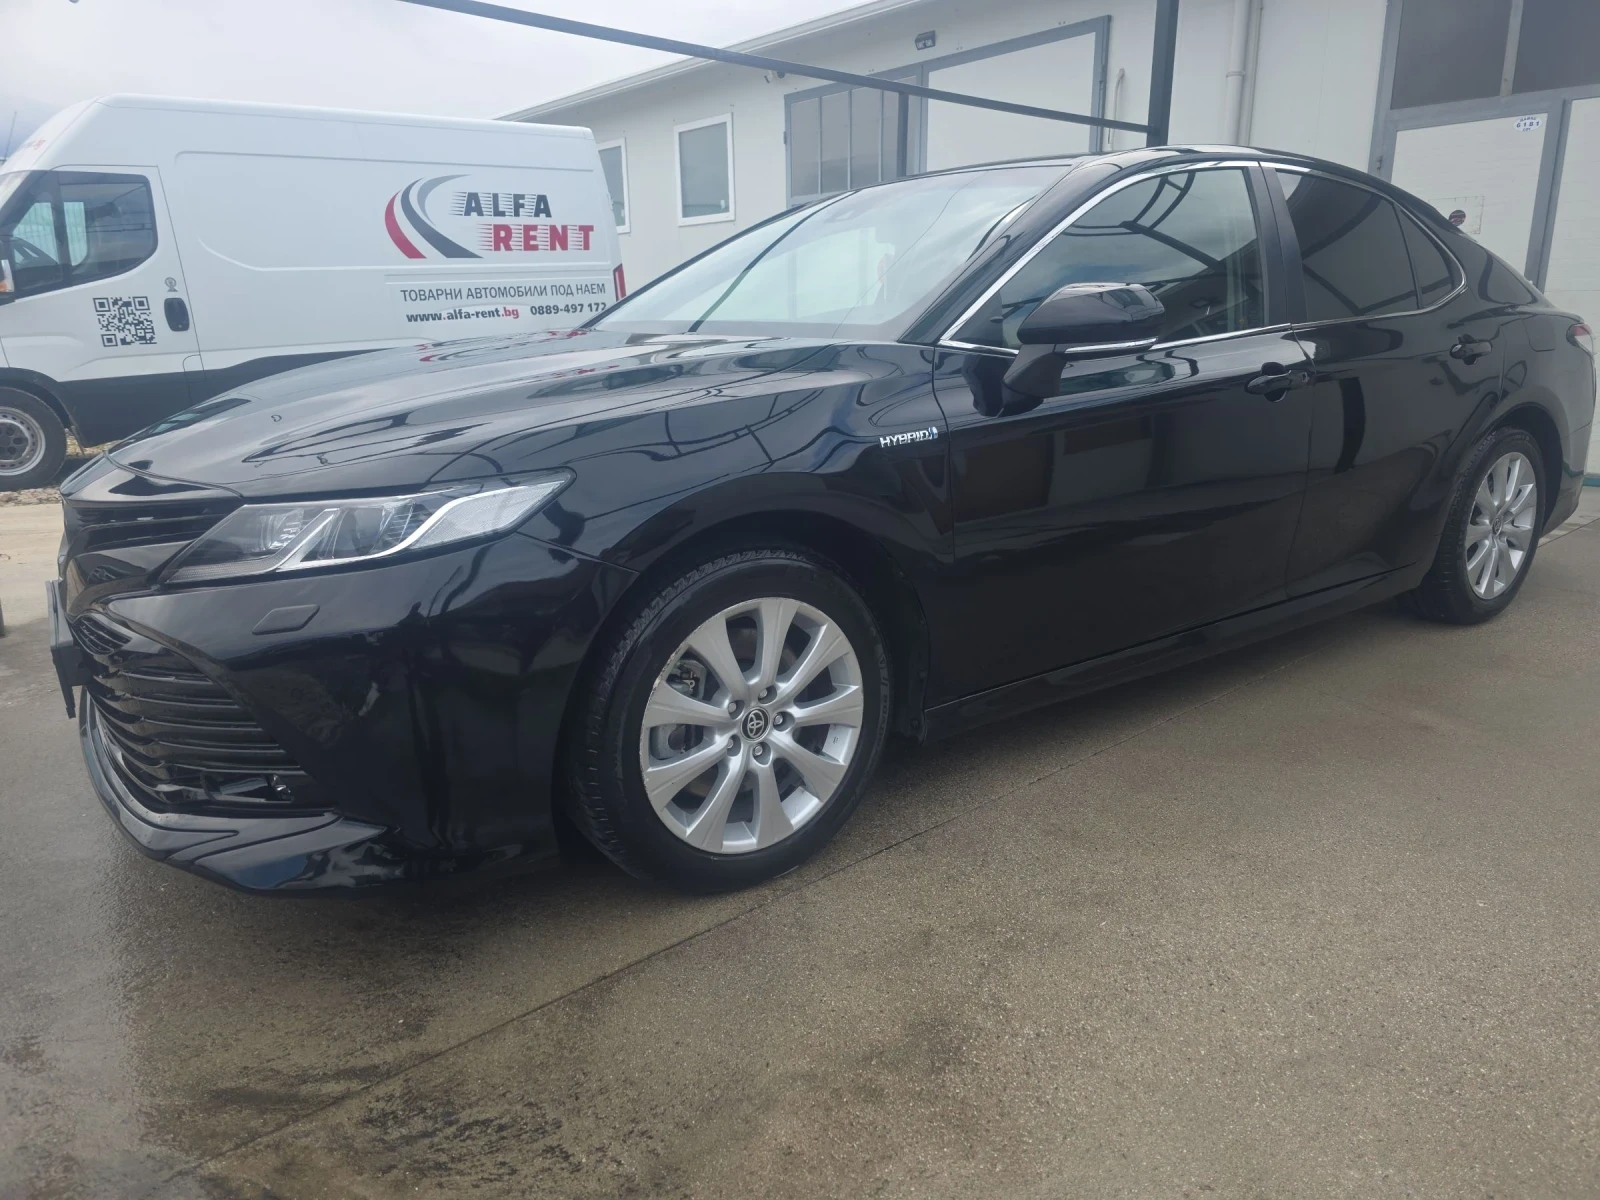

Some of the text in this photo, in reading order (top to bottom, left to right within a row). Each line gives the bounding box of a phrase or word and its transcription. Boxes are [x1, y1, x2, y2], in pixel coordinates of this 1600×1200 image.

[463, 191, 552, 218] ALFA
[492, 224, 594, 252] RENT
[400, 283, 606, 302] ТОВАРНИ АВТОМОБИЛИ ПОД НАЕМ
[406, 306, 520, 323] www.alfa-rent.bg
[530, 303, 584, 315] 0889-497
[879, 430, 930, 448] HYBRID
